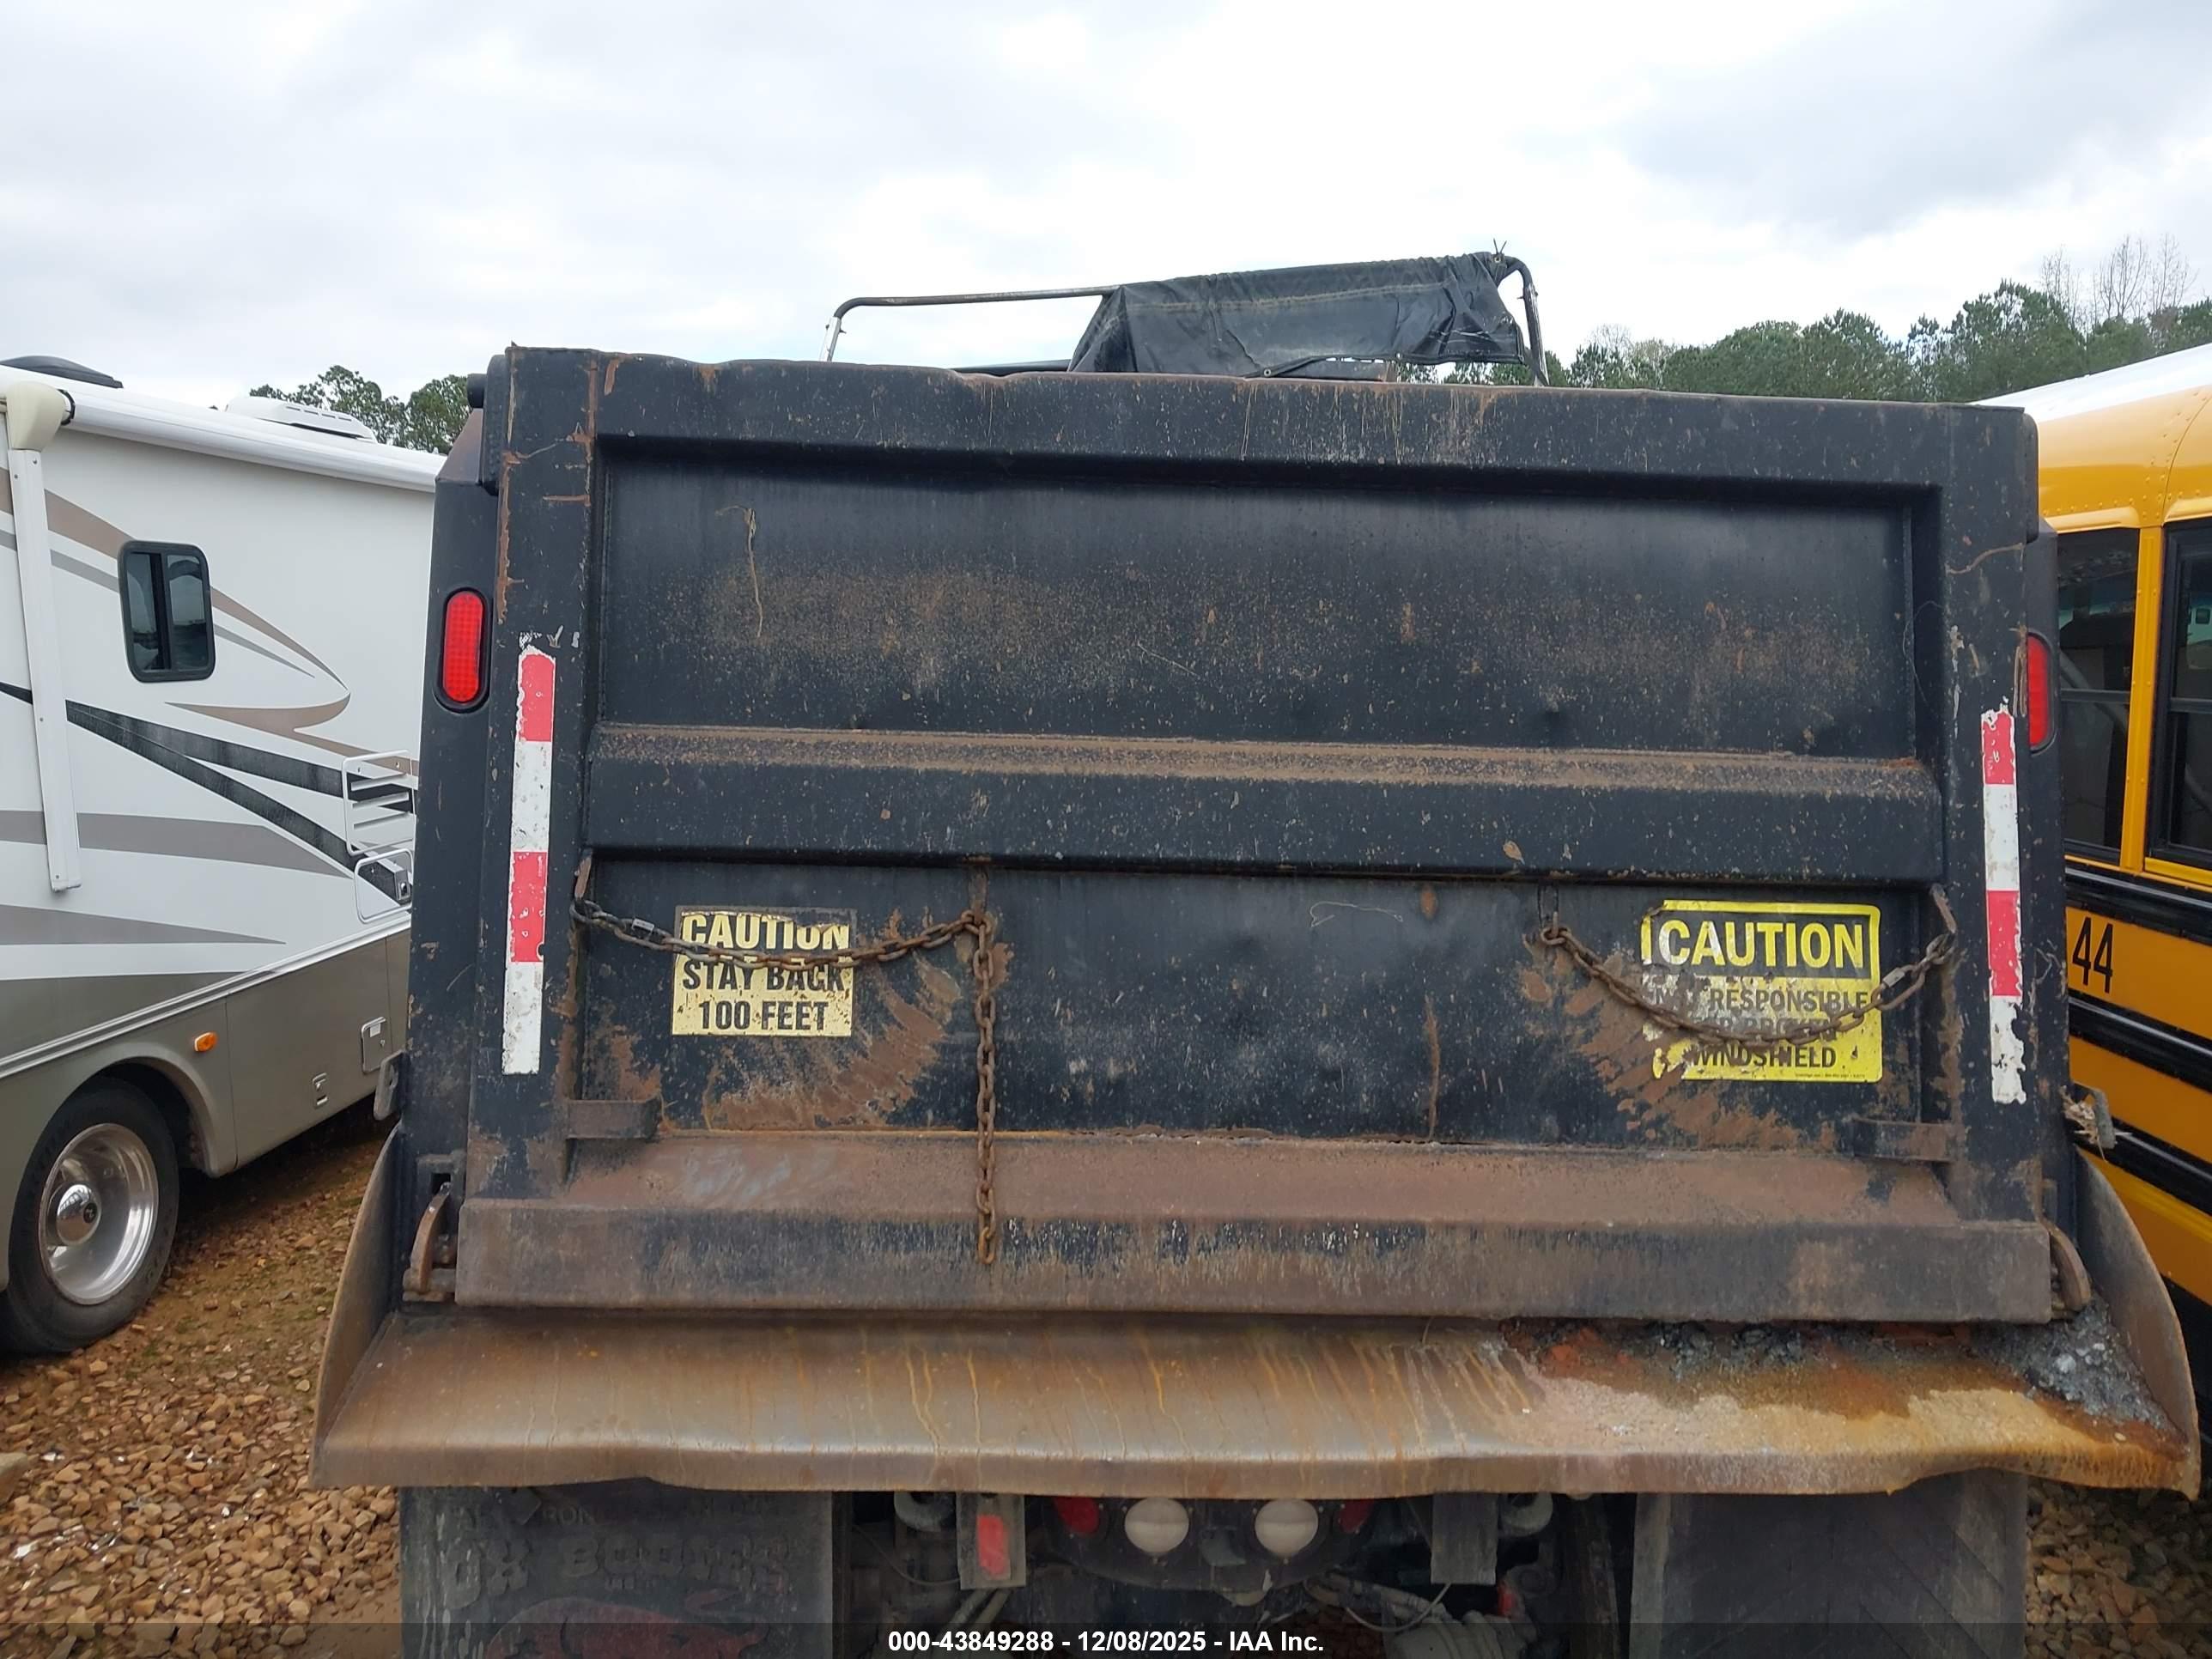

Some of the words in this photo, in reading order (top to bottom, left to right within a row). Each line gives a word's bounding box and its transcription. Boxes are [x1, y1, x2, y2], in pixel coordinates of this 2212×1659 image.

[683, 914, 848, 951] CAUTION
[1658, 920, 1863, 969] CAUTION
[2072, 916, 2113, 994] 44
[683, 959, 758, 990] STAY
[767, 962, 843, 991] BACK
[699, 1000, 750, 1030] 100
[762, 1000, 829, 1030] FEET
[1710, 988, 1869, 1013] RESPONSIBLE
